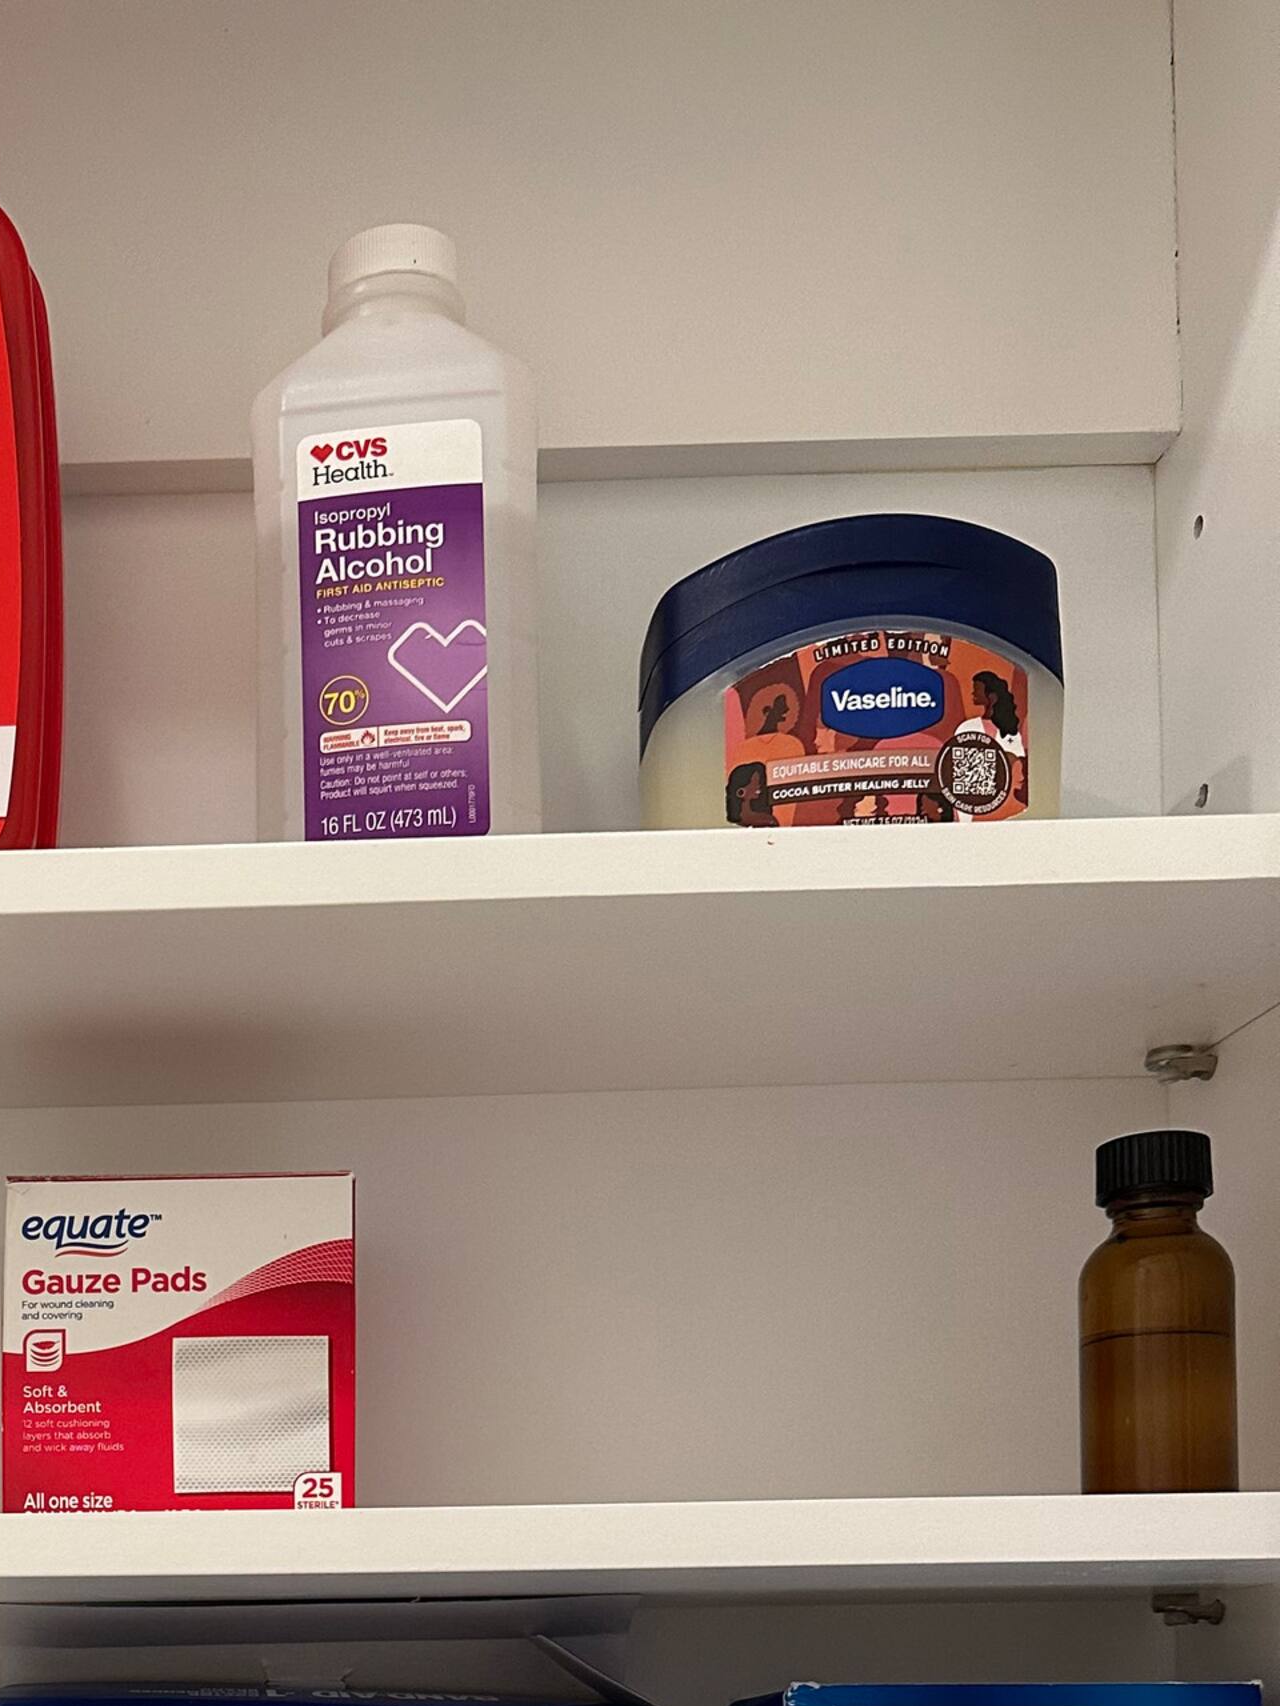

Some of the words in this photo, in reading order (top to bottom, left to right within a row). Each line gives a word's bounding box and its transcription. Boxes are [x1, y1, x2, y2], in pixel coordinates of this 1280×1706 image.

[335, 436, 388, 462] CVS
[312, 459, 389, 486] Health
[314, 502, 391, 525] Isopropyl
[314, 519, 444, 554] Rubbing
[315, 548, 433, 585] Alcohol
[316, 587, 349, 600] FIRST
[352, 584, 373, 595] AID
[375, 576, 445, 592] ANTISEPTIC
[815, 638, 881, 662] LIMITED
[887, 637, 950, 658] EDITION
[830, 687, 937, 712] Vaseline.
[772, 760, 830, 779] EQUITABLE
[832, 756, 887, 772] SKINCARE
[888, 755, 908, 768] FOR
[911, 754, 932, 767] ALL
[772, 785, 810, 800] COCOA
[811, 781, 852, 796] BUTTER
[854, 779, 900, 793] HEALING
[901, 777, 932, 790] JELLY
[321, 817, 339, 836] 16
[343, 814, 362, 832] FL
[365, 811, 387, 831] OZ
[390, 808, 424, 831] (473
[427, 805, 458, 828] mL)
[21, 1208, 151, 1250] equate
[22, 1269, 122, 1295] Gauze
[131, 1265, 208, 1293] Pads
[21, 1311, 40, 1321] and
[42, 1310, 83, 1322] covering
[22, 1300, 38, 1309] For
[40, 1299, 73, 1309] wound
[75, 1299, 114, 1311] cleaning
[22, 1385, 54, 1398] Soft
[57, 1385, 68, 1398] &
[23, 1400, 102, 1414] Absorbent
[302, 1477, 334, 1498] 25
[23, 1492, 46, 1510] All
[48, 1494, 80, 1510] one
[82, 1492, 113, 1509] size
